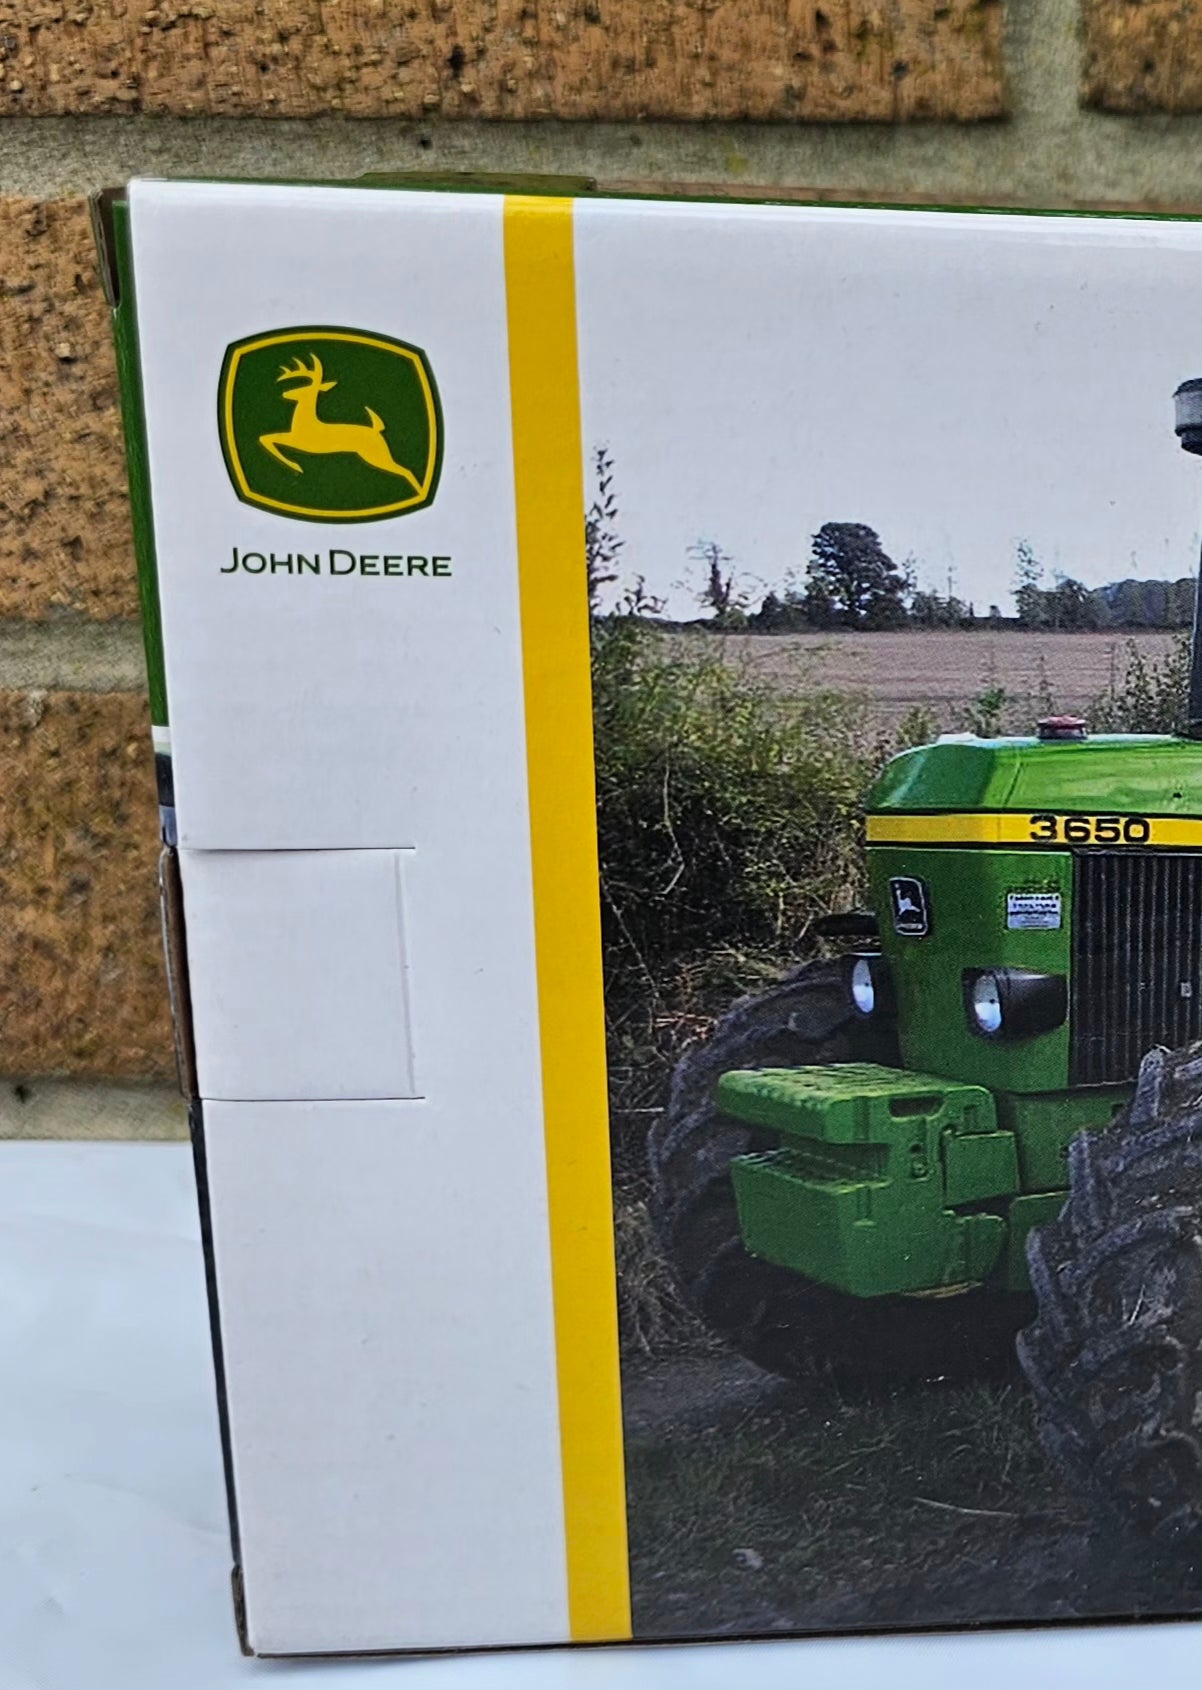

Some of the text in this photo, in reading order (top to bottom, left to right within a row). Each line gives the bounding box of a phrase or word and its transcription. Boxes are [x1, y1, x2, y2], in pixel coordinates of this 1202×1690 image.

[220, 547, 452, 577] JOHN DEERE
[1029, 815, 1151, 844] 3650
